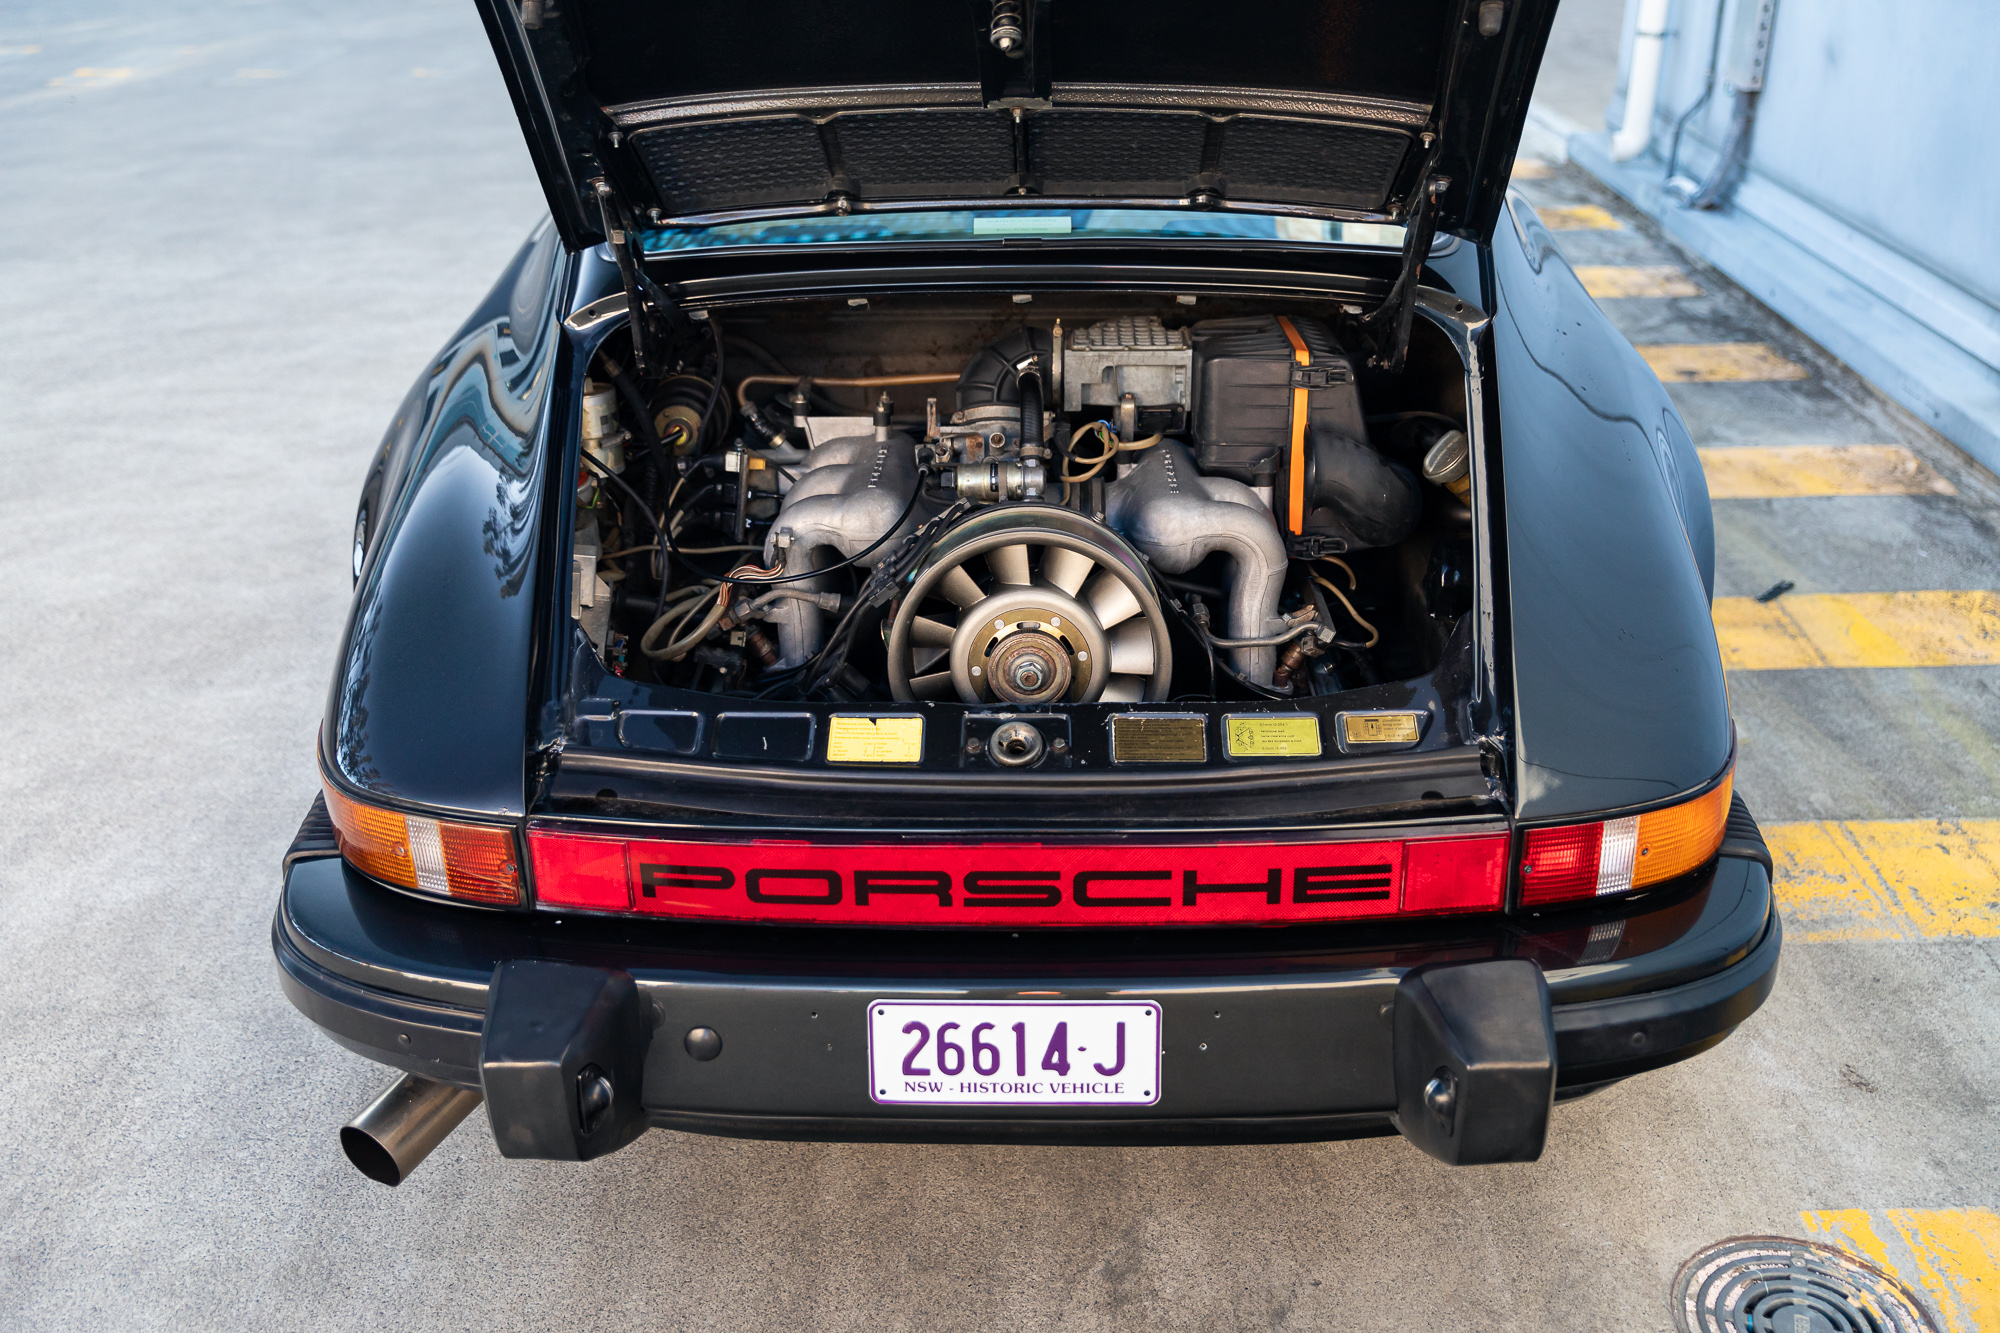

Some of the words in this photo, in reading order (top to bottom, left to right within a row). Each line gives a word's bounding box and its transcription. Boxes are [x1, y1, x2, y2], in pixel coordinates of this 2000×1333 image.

[639, 862, 1393, 908] PORSCHE
[904, 1081, 944, 1093] NSW
[959, 1082, 1044, 1094] HISTORIC
[1049, 1082, 1125, 1094] VEHICLE
